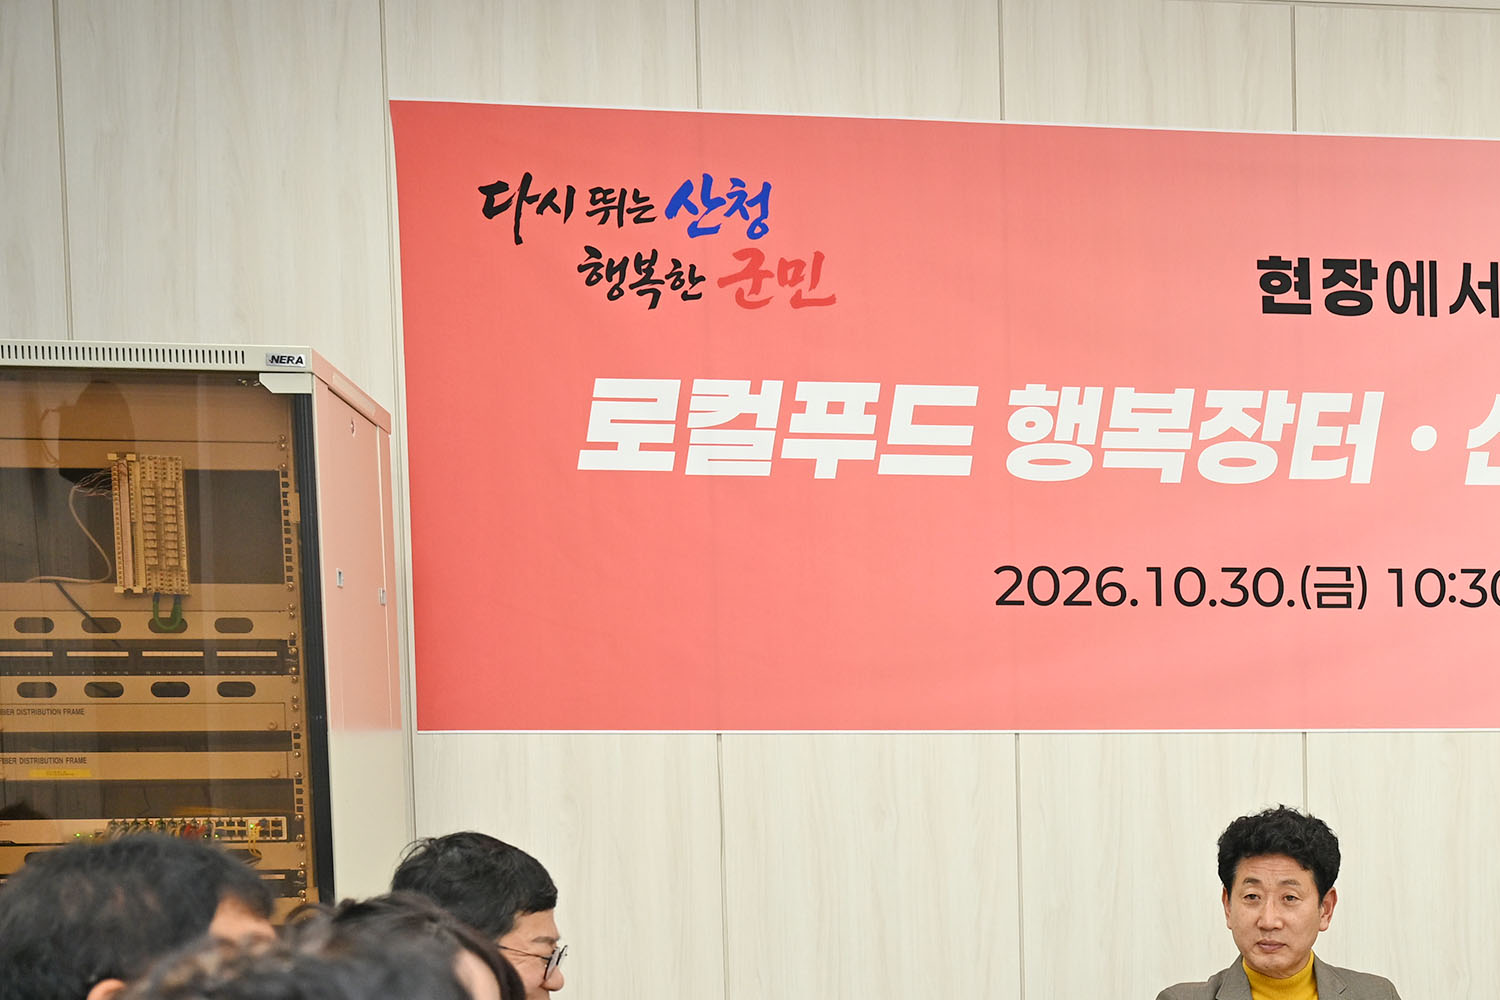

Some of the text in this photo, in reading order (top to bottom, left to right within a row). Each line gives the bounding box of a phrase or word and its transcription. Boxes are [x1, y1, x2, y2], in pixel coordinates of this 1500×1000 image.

[479, 173, 773, 246] 다시 뛰는 산청
[578, 246, 837, 311] 행복한 군민
[1258, 256, 1500, 319] 현장에서
[270, 354, 304, 365] NERA
[578, 378, 980, 480] 로컬푸드
[1006, 384, 1386, 486] 행복장터
[994, 565, 1369, 612] 2026.10.30.(금)
[63, 707, 85, 716] FRAME
[66, 756, 87, 765] FRAME
